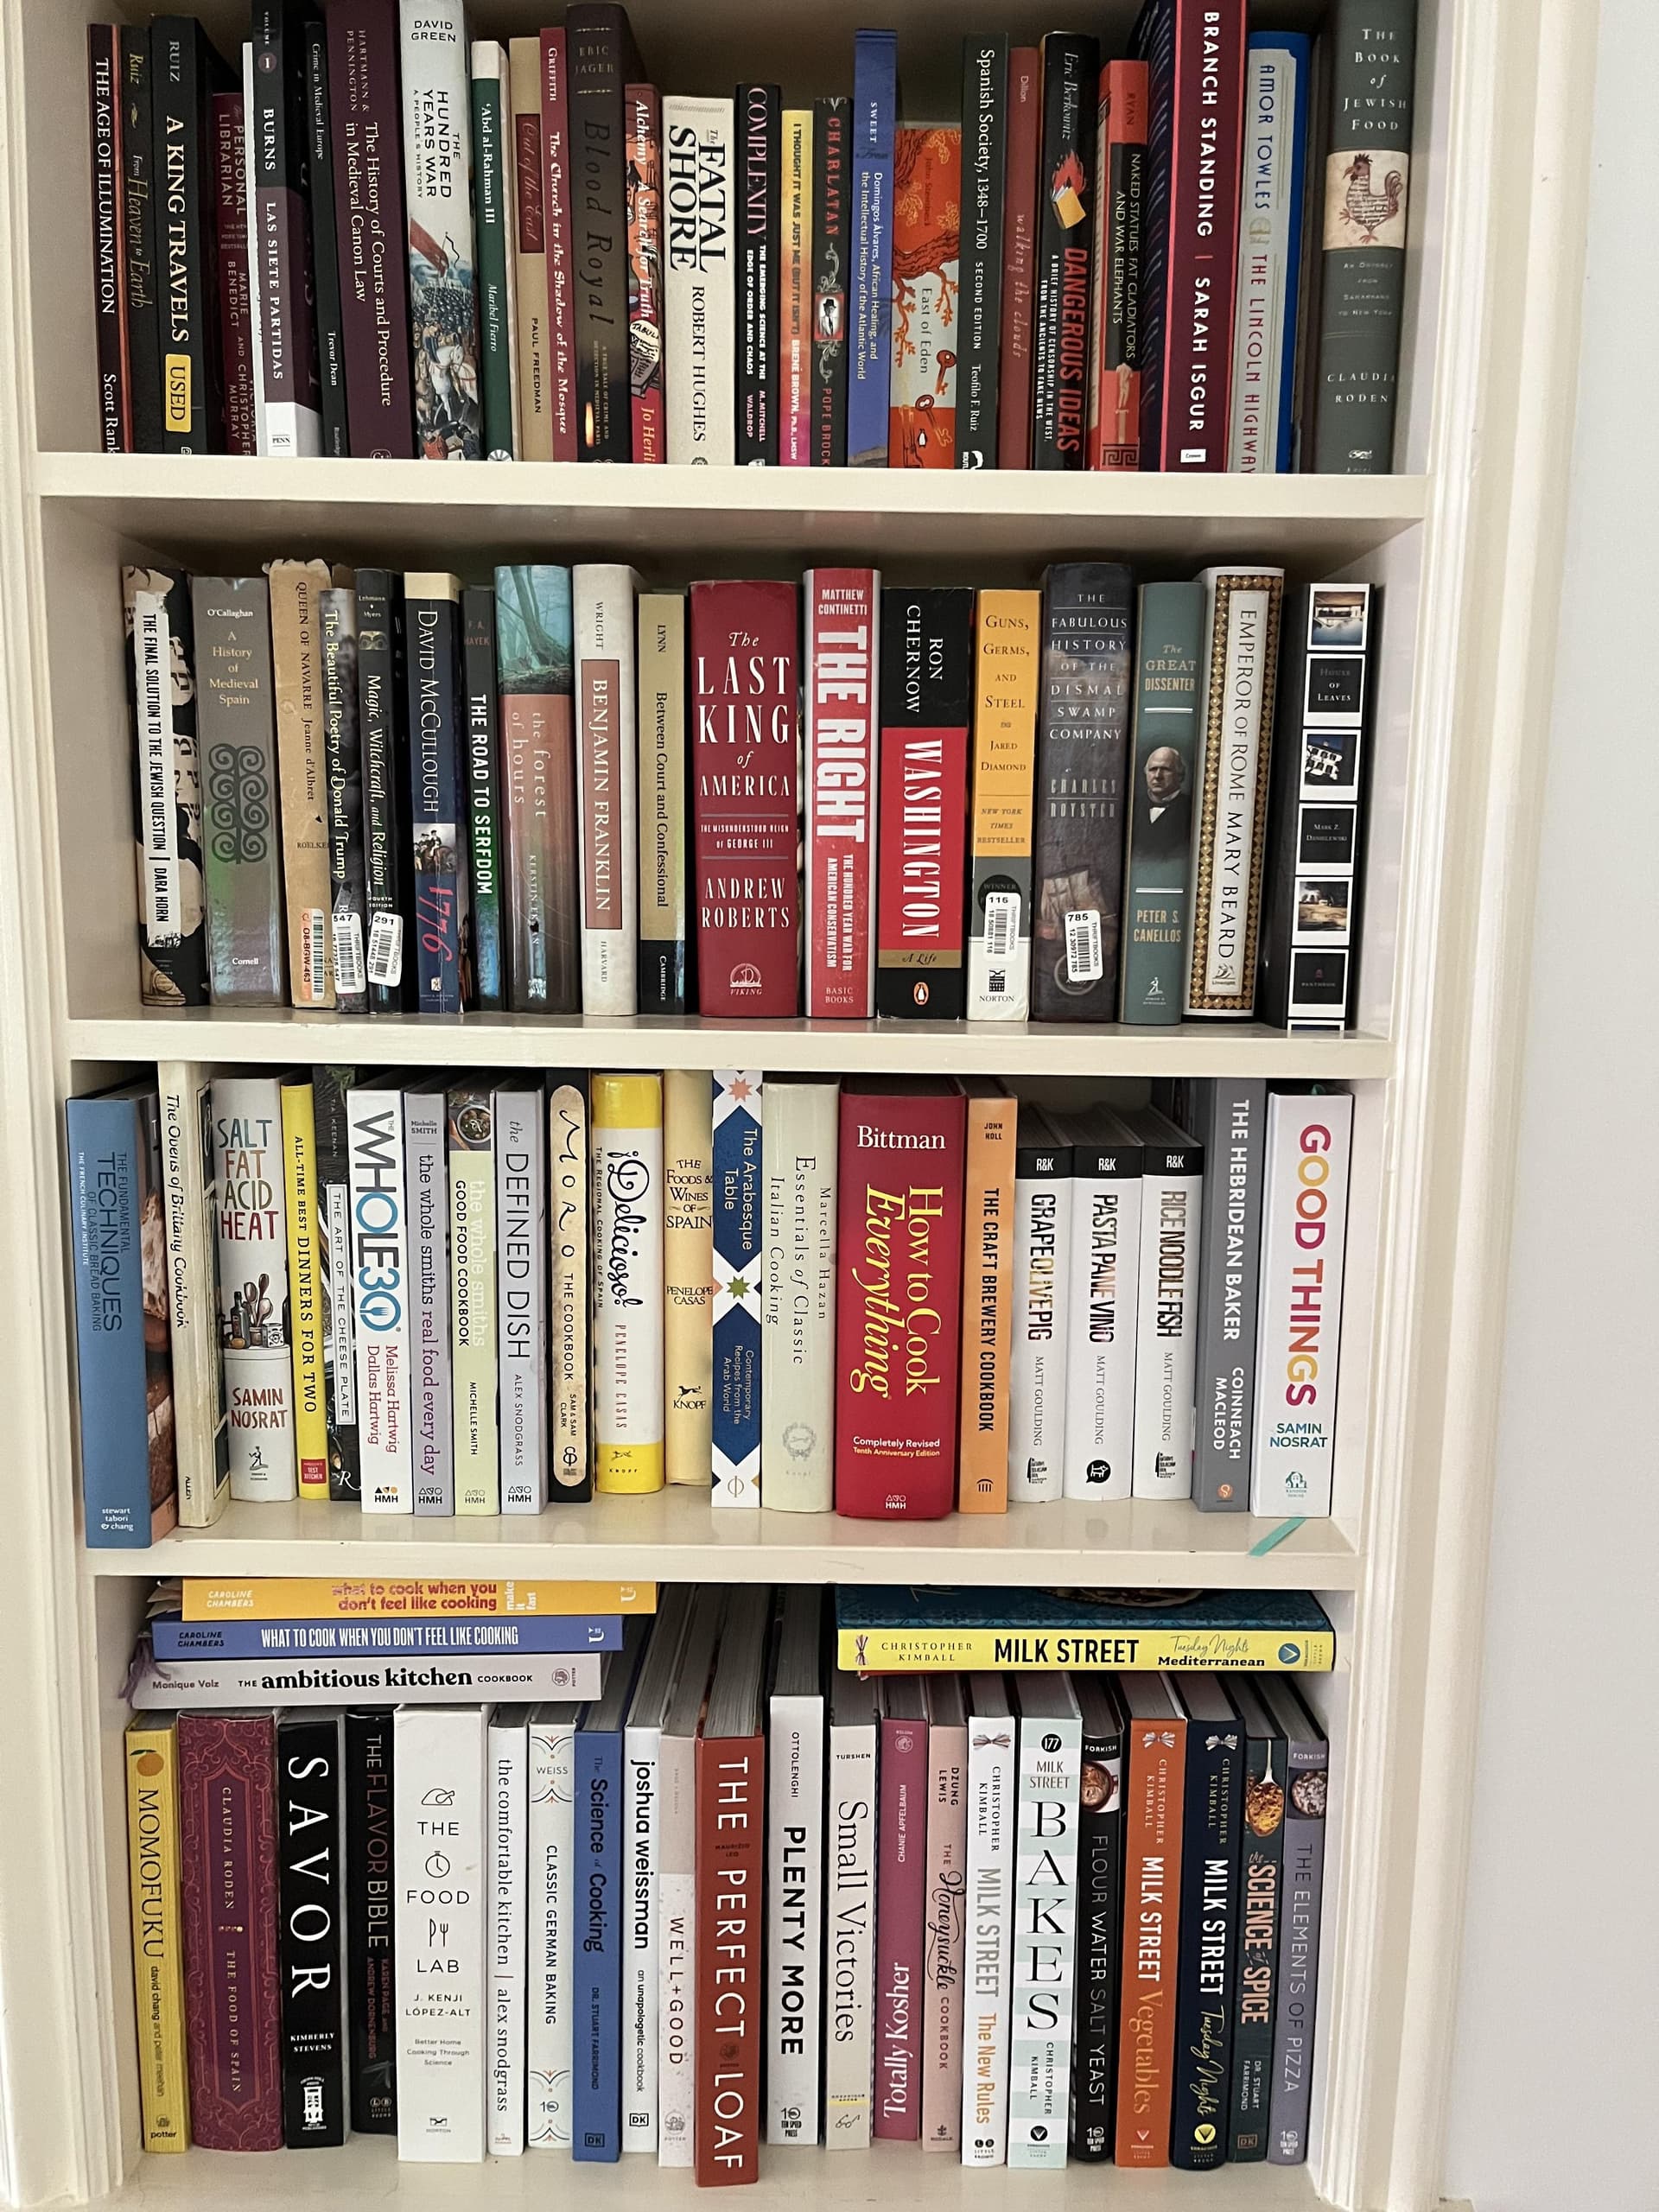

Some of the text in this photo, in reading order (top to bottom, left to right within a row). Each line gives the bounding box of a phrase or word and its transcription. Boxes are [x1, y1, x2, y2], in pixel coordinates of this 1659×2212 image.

[411, 32, 456, 42] GREEN
[414, 21, 454, 30] DAVID
[976, 49, 995, 109] Spanish
[264, 108, 276, 171] BURNS
[424, 89, 436, 197] YEARS WAR
[438, 91, 451, 199] HUNDRED
[975, 114, 993, 173] Society,
[1198, 12, 1218, 236] BRANCH STANDING
[167, 116, 189, 342] A KING TRAVELS
[669, 124, 696, 271] SHORE
[697, 142, 726, 272] FATAL
[266, 202, 283, 380] LAS SIETE PARTIDAS
[973, 262, 983, 349] SECOND EDITION
[919, 289, 933, 374] East of Eden
[1057, 247, 1088, 453] DANGEROUS IDEAS
[1190, 277, 1210, 431] SARAH ISGUR
[168, 365, 186, 421] USED
[532, 353, 542, 413] FREEDMAN
[692, 286, 705, 442] ROBERT HUGHES
[818, 604, 868, 615] CONTINETTI
[823, 588, 864, 601] MATTHEW
[698, 657, 791, 695] LAST
[906, 605, 921, 714] CHERNOW
[929, 638, 943, 681] RON
[143, 613, 166, 850] THE FINAL SOLUTION TO THE JEWISH QUESTION
[699, 704, 790, 744] KING
[817, 626, 868, 842] THE RIGHT
[700, 776, 790, 797] AMERICA
[736, 751, 753, 768] of
[1217, 610, 1257, 959] EMPEROR OF ROME MARY BEARD
[471, 694, 493, 894] THE ROAD TO SERFDOM
[593, 679, 611, 912] BENJAMIN FRANKLIN
[902, 740, 943, 938] WASHINGTON
[154, 868, 169, 922] DARA HORN
[374, 916, 395, 925] 291
[702, 907, 790, 927] ROBERTS
[705, 878, 785, 900] ANDREW
[1067, 912, 1088, 923] 785
[1134, 929, 1181, 943] CANELLOS
[219, 1119, 272, 1148] SALT
[226, 1149, 265, 1179] FAT
[857, 1126, 945, 1150] Bittman
[1098, 1158, 1116, 1171] R&K
[226, 1180, 272, 1209] ACID
[724, 1167, 734, 1210] Table
[741, 1128, 757, 1250] The Arabesque
[221, 1211, 279, 1240] HEAT
[505, 1121, 530, 1358] the DEFINED DISH
[295, 1136, 317, 1413] ALL-TIME BEST DINNERS FOR TWO
[850, 1183, 906, 1401] Everything
[906, 1185, 943, 1395] How to Cook
[1286, 1124, 1332, 1407] GOOD THINGS
[419, 1154, 440, 1476] the whole smiths real food every day
[978, 1188, 1000, 1431] THE CRAFT BREWERY COOKBOOK
[232, 1408, 287, 1428] NOSRAT
[233, 1387, 283, 1406] SAMIN
[853, 1436, 940, 1448] Completely Revised
[1269, 1436, 1327, 1448] NOSRAT
[1276, 1423, 1322, 1435] SAMIN
[261, 1629, 290, 1648] WHAT
[292, 1629, 307, 1647] TO
[308, 1629, 336, 1647] COOK
[339, 1628, 369, 1647] WHEN
[371, 1628, 391, 1646] YOU
[425, 1627, 448, 1645] FEEL
[449, 1626, 473, 1645] LIKE
[474, 1626, 518, 1645] COOKING
[881, 1643, 971, 1651] CHRISTOPHER
[995, 1638, 1139, 1663] MILK STREET
[1158, 1656, 1264, 1667] Mediterranean
[261, 1669, 380, 1689] ambitious
[385, 1667, 473, 1687] kitchen
[537, 1766, 568, 1775] WEISS
[718, 1758, 748, 1831] THE
[791, 1732, 800, 1798] OTTOLENGHI
[417, 1822, 459, 1835] THE
[631, 1760, 656, 1950] joshua weissman
[138, 1789, 163, 1959] MOMOFUKU
[289, 1756, 331, 1998] SAVOR
[497, 1759, 514, 1966] the comfortable kitchen
[407, 1891, 470, 1904] FOOD
[836, 1802, 868, 2042] Small Victories
[1027, 1802, 1069, 2031] BAKES
[545, 1845, 557, 2024] CLASSIC GERMAN BAKING
[715, 1870, 747, 2038] PERFECT
[781, 1827, 806, 2055] PLENTY MORE
[417, 1960, 459, 1973] LAB
[406, 2006, 471, 2016] LÓPEZ-ALT
[883, 1962, 913, 2119] Totally Kosher
[493, 1989, 511, 2113] alex snodgrass
[714, 2074, 743, 2169] LOAF
